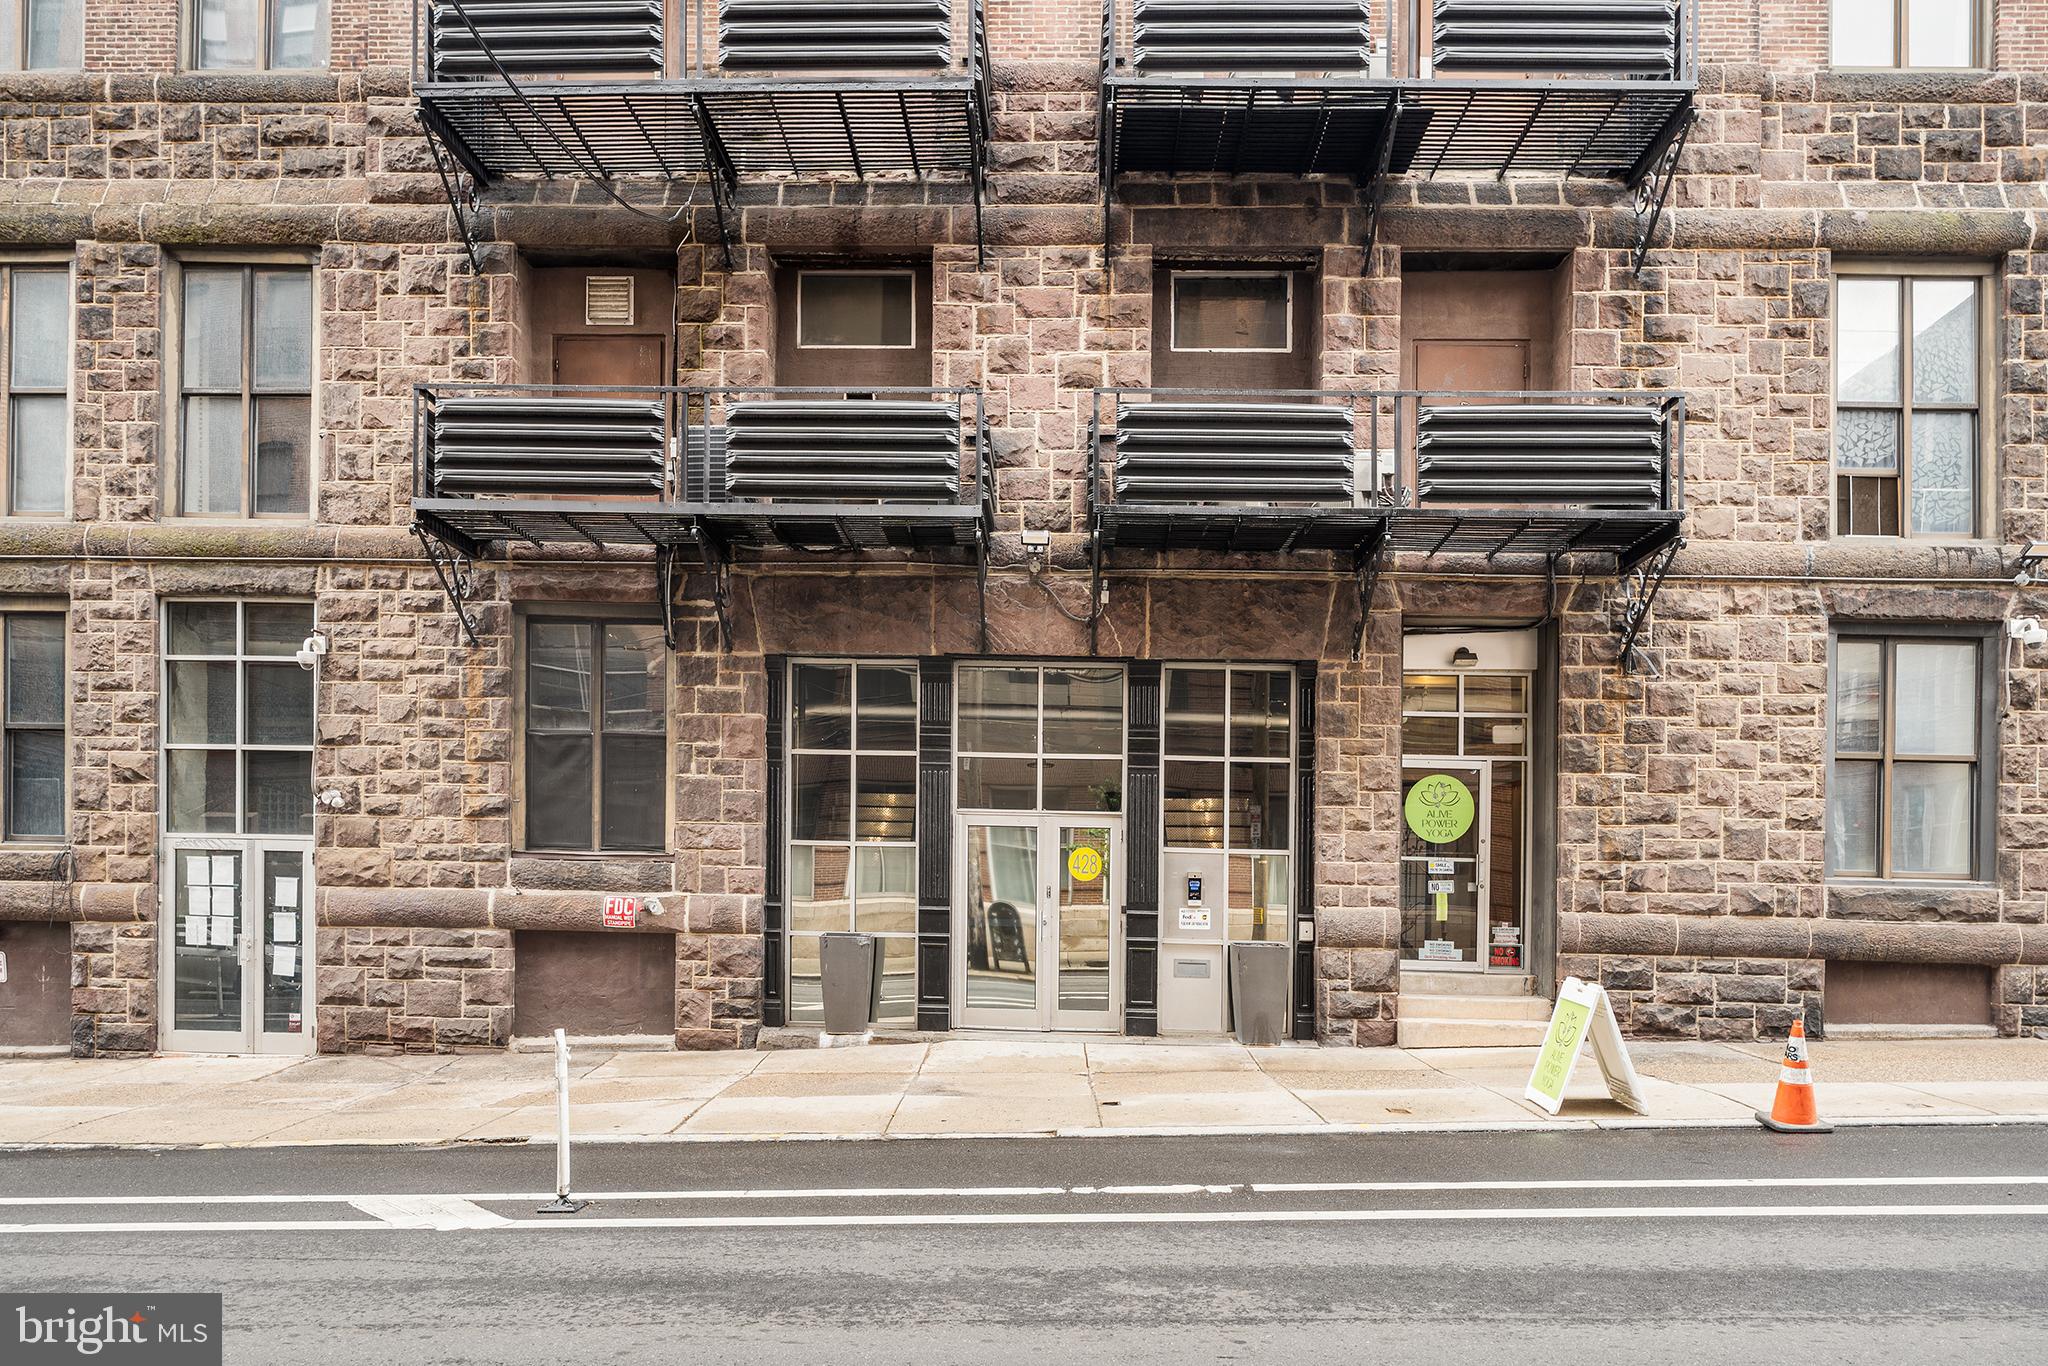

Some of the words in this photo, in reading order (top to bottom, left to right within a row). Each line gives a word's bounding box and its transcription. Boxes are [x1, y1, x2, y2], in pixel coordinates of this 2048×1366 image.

[1426, 809, 1453, 818] ALIVE
[1421, 819, 1458, 828] POWER
[1426, 829, 1454, 838] YOGA
[1073, 854, 1098, 874] 428
[1431, 883, 1440, 891] NO
[606, 897, 633, 915] FDC
[1494, 947, 1504, 956] NO
[1490, 956, 1519, 966] SMOKING
